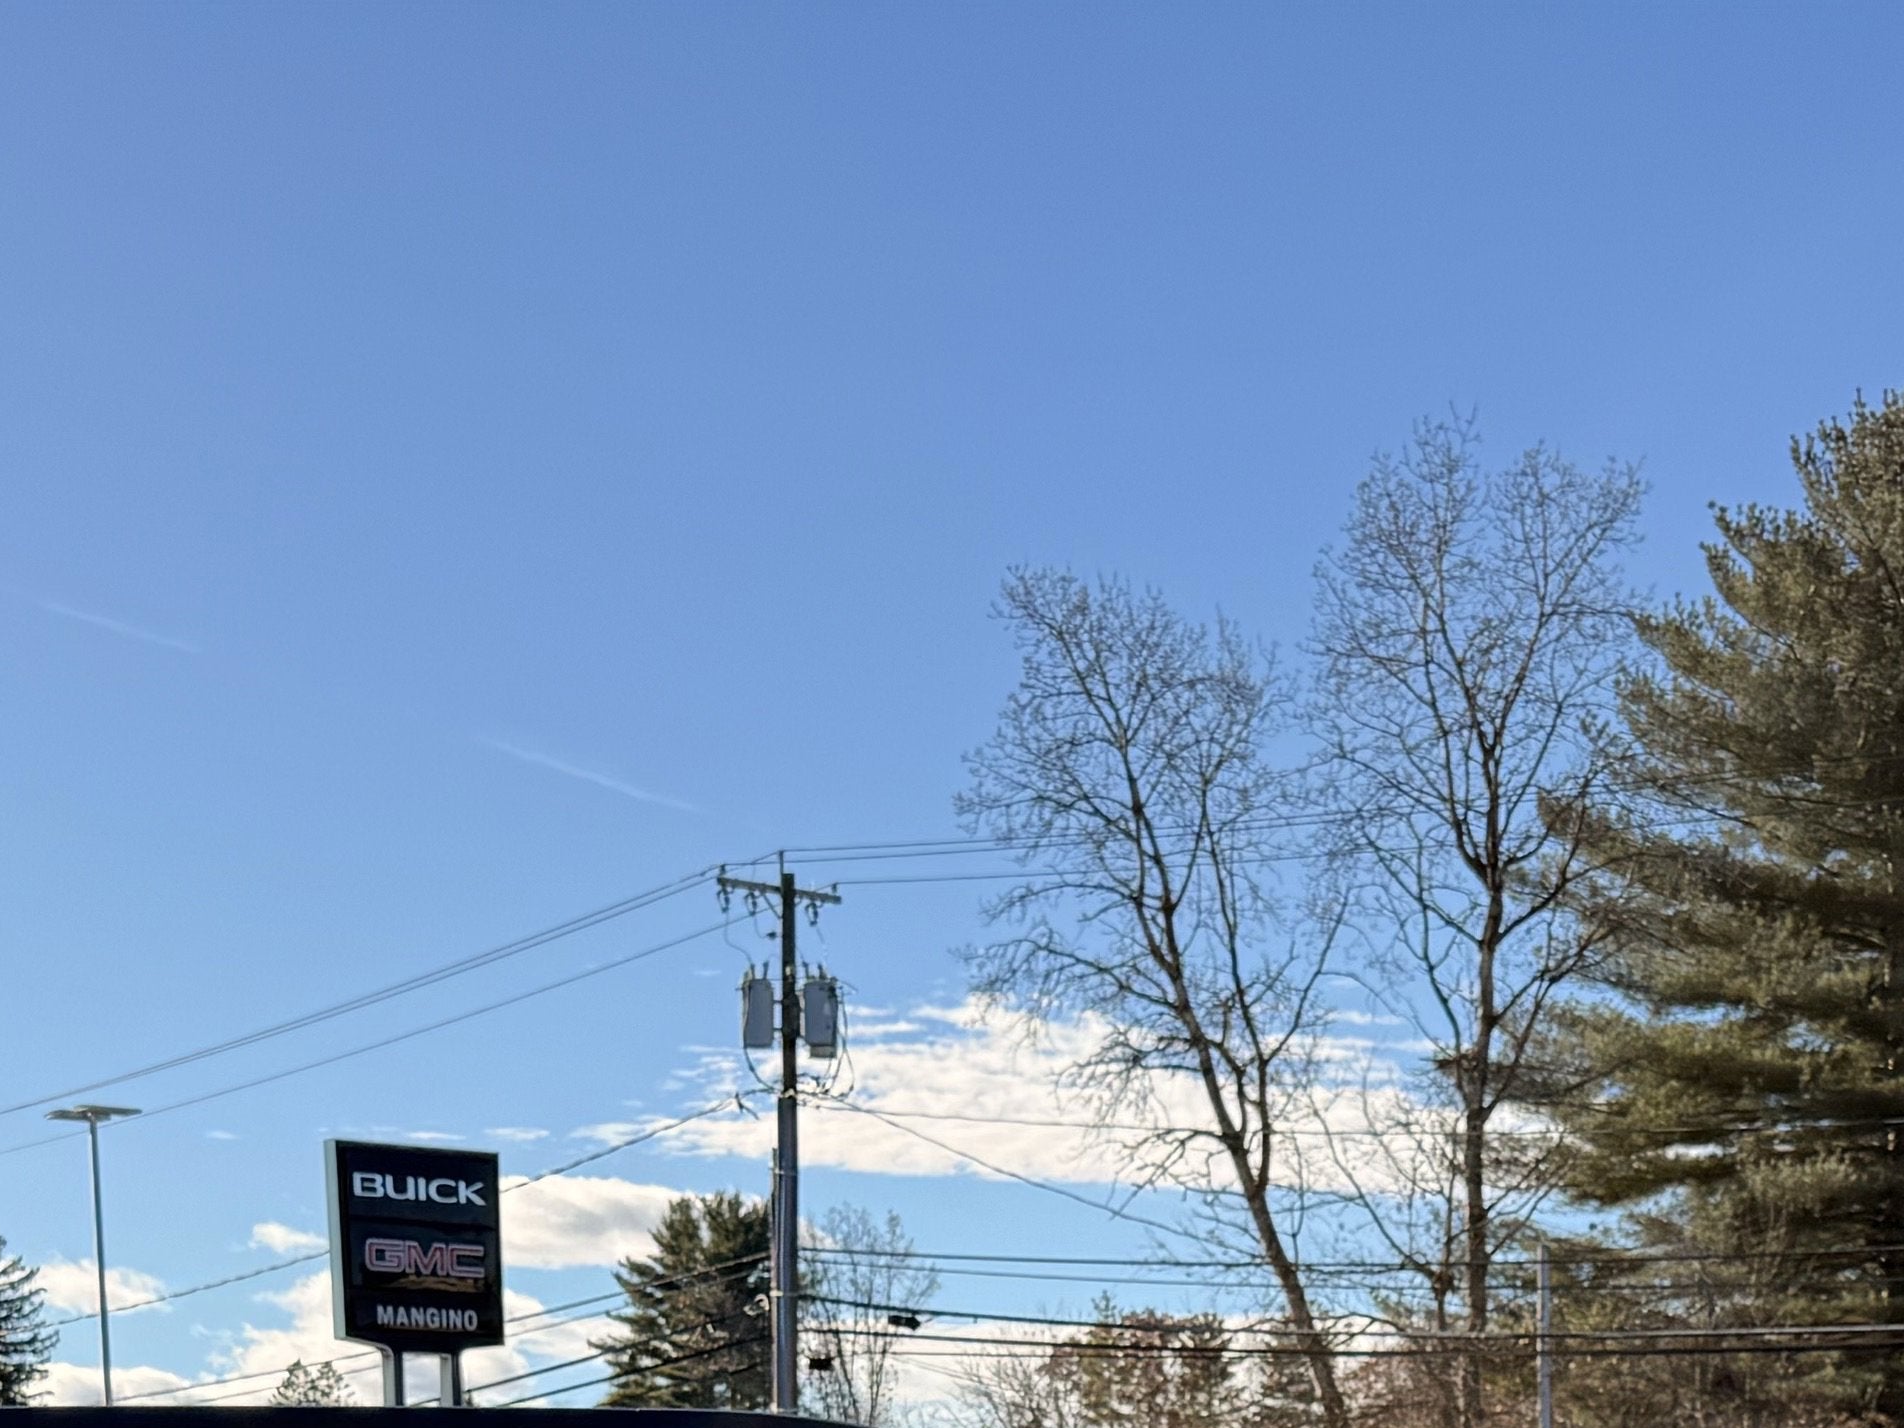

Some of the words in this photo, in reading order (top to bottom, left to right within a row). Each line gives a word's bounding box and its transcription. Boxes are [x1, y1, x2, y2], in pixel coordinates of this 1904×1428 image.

[352, 1171, 487, 1206] BUICK
[365, 1237, 486, 1278] GMC
[376, 1304, 478, 1332] MANGINO
